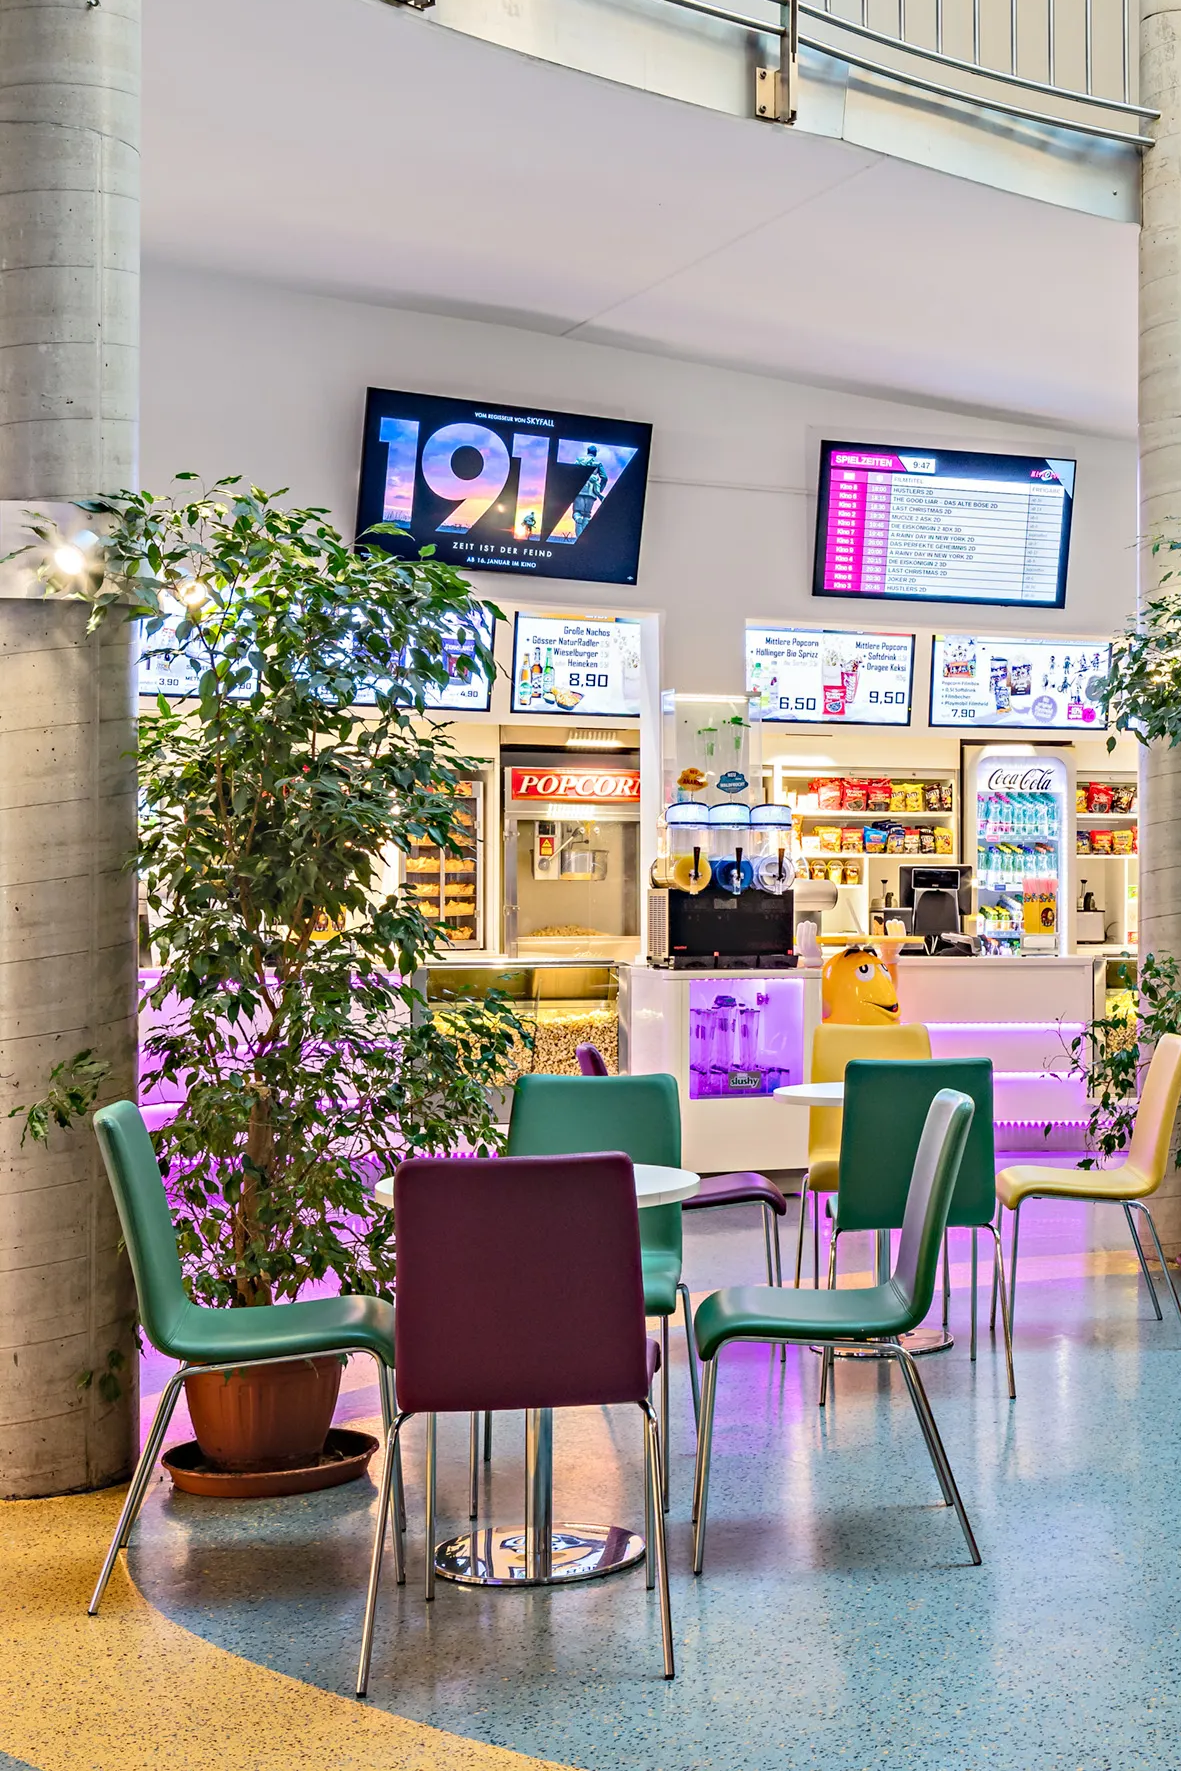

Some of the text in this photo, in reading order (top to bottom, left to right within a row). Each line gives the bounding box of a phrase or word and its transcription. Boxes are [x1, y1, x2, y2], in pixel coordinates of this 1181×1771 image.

[488, 413, 513, 422] REGISSEUR
[514, 416, 526, 424] VON
[526, 416, 555, 428] SKYFALL
[835, 455, 931, 469] SPIELZEITEN 9:47
[379, 416, 639, 545] 1917
[452, 541, 553, 558] ZEIT IST DER FEIND
[466, 556, 475, 564] AB
[486, 558, 511, 566] JANUAR
[520, 560, 537, 568] KINO
[563, 626, 611, 637] Große Nachos
[558, 637, 600, 647] NaturRadler
[765, 637, 819, 648] Mittlere Popcorn
[855, 641, 908, 652] Mittlere Popcorn
[553, 647, 599, 659] Wieselburger
[786, 649, 797, 658] Bio
[798, 649, 818, 659] Sprizz
[868, 653, 897, 661] Softdrink
[567, 658, 598, 668] Heineken
[866, 662, 907, 672] Dragee Keksi
[987, 768, 1055, 791] Coca-Cola
[730, 1076, 760, 1088] slushy
